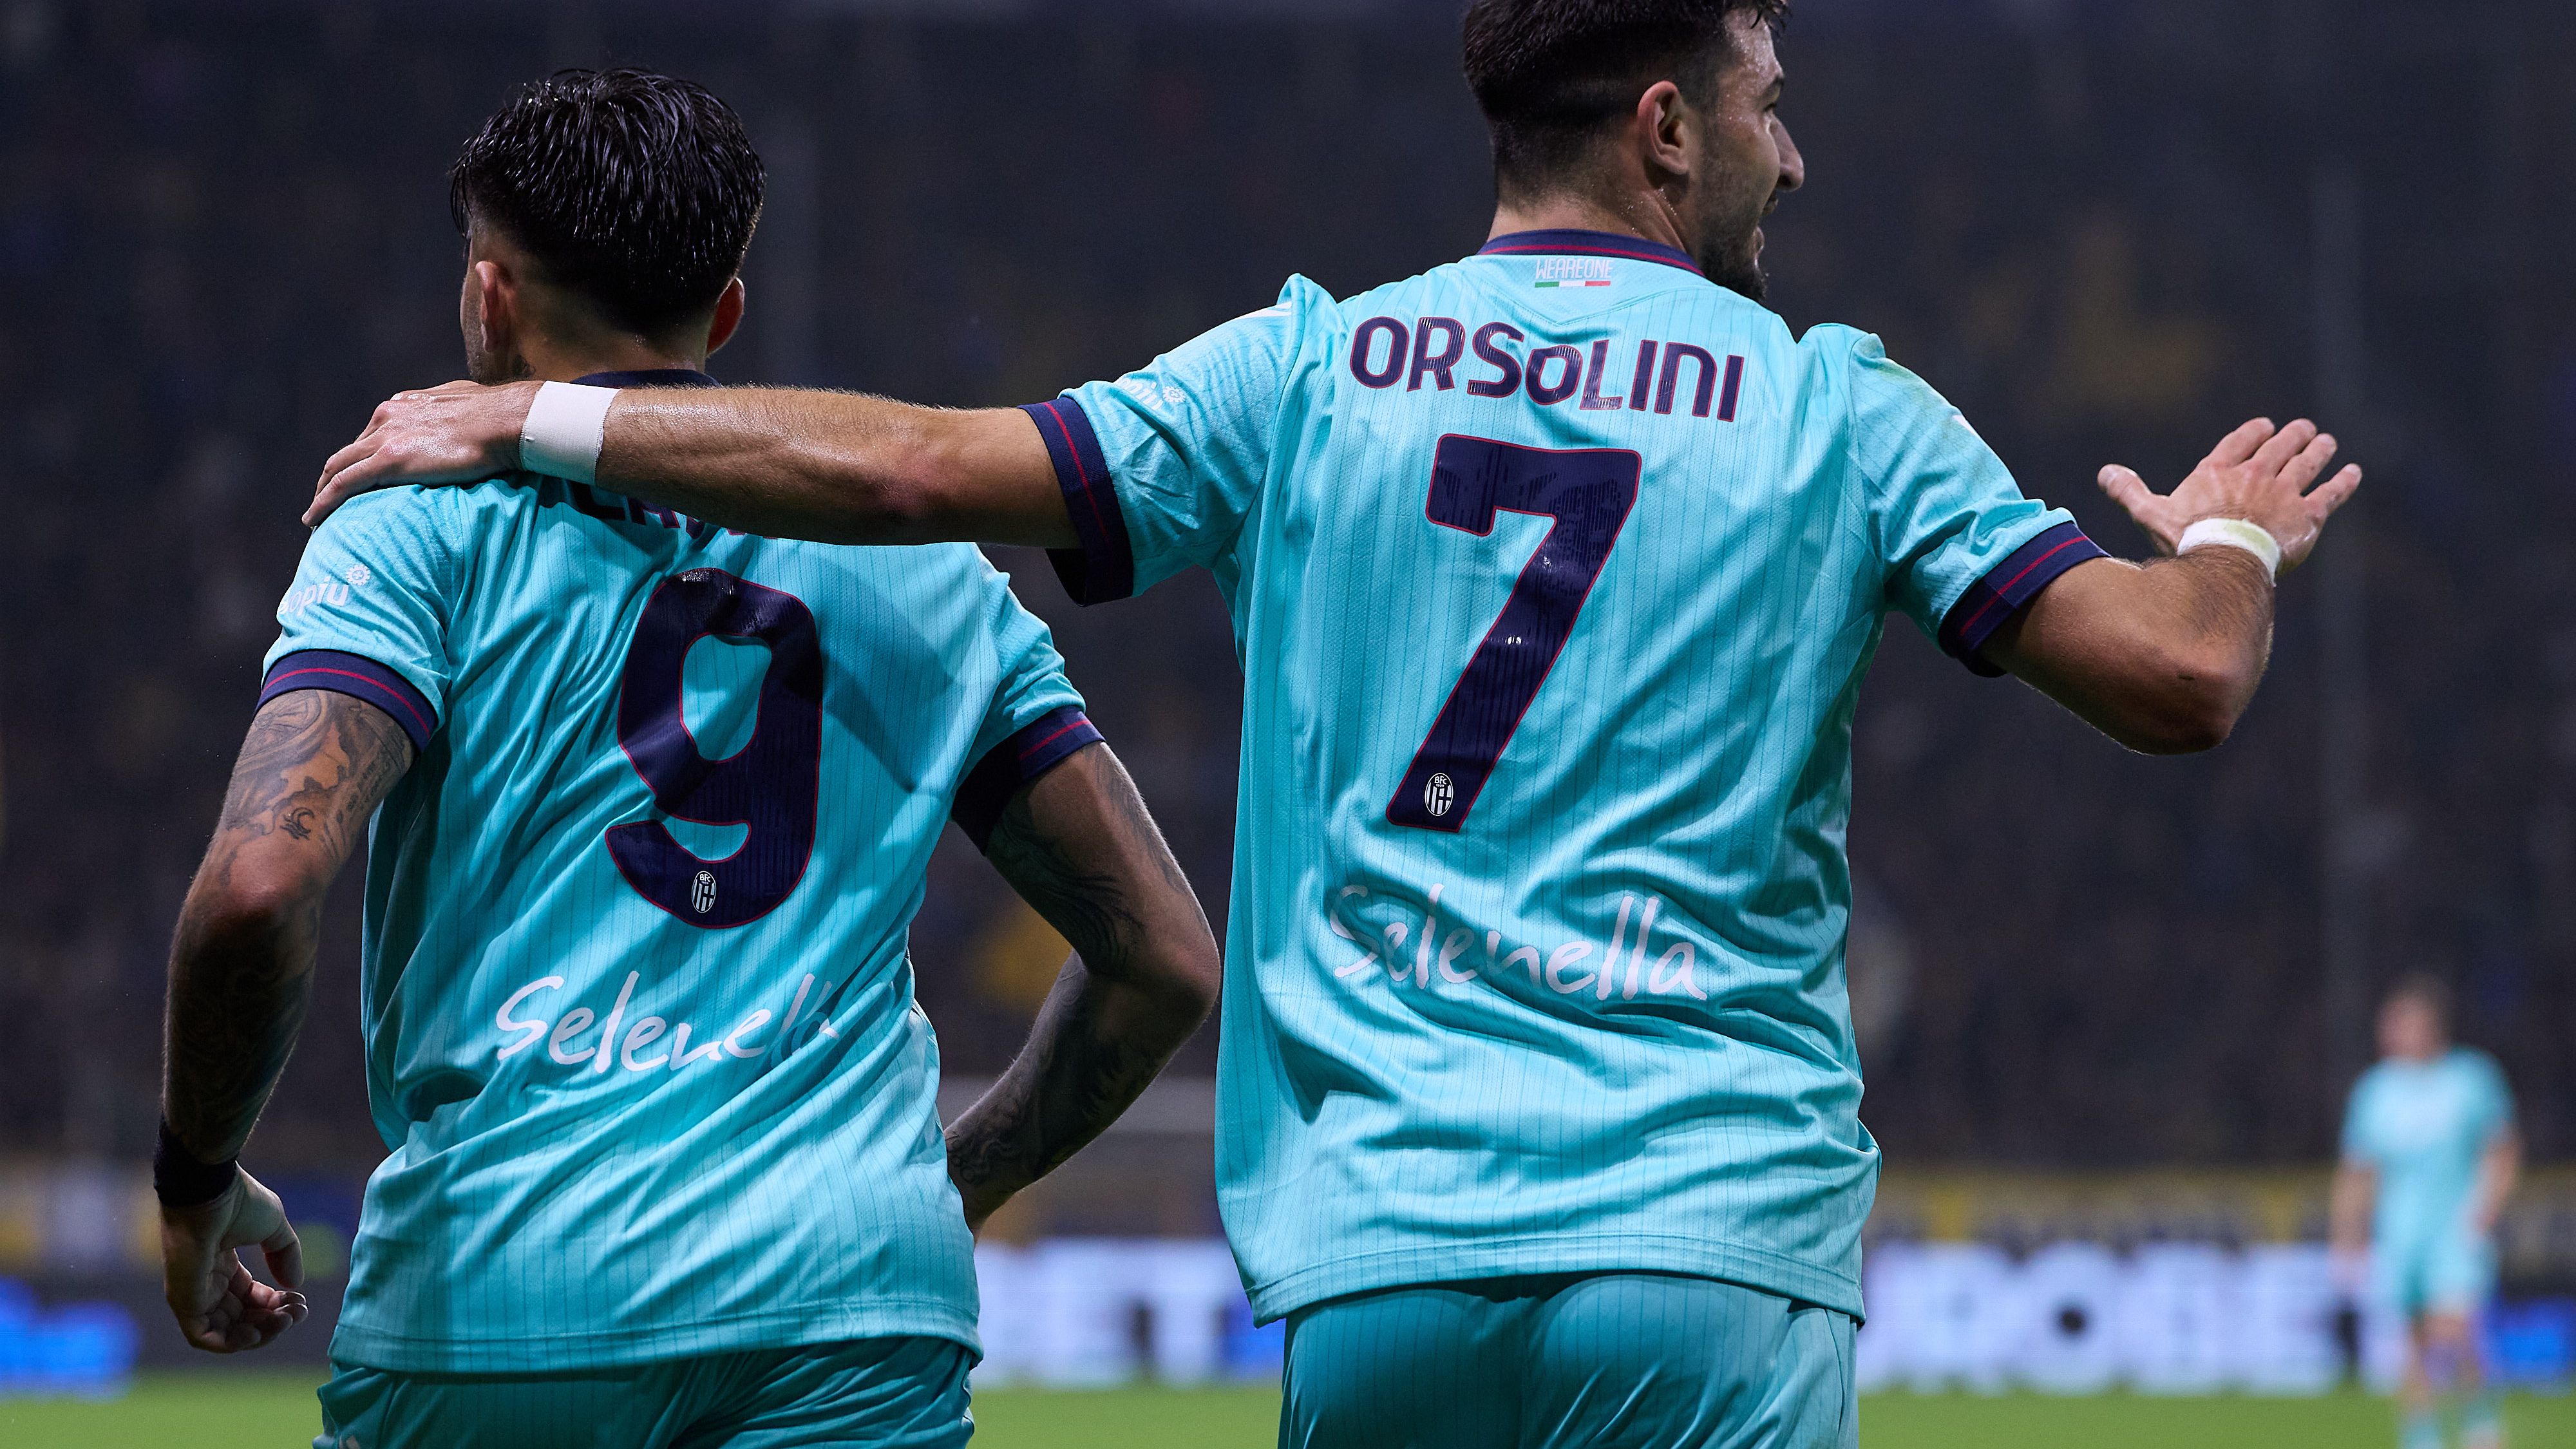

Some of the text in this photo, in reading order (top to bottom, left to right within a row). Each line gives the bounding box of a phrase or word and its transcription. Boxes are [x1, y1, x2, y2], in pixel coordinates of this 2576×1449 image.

[1350, 316, 1745, 422] ORSOLINI
[1387, 433, 1642, 833] 7
[605, 567, 823, 929] 9
[1434, 775, 1447, 784] BFC
[699, 873, 711, 882] BFC
[1330, 883, 1708, 1001] Selenella
